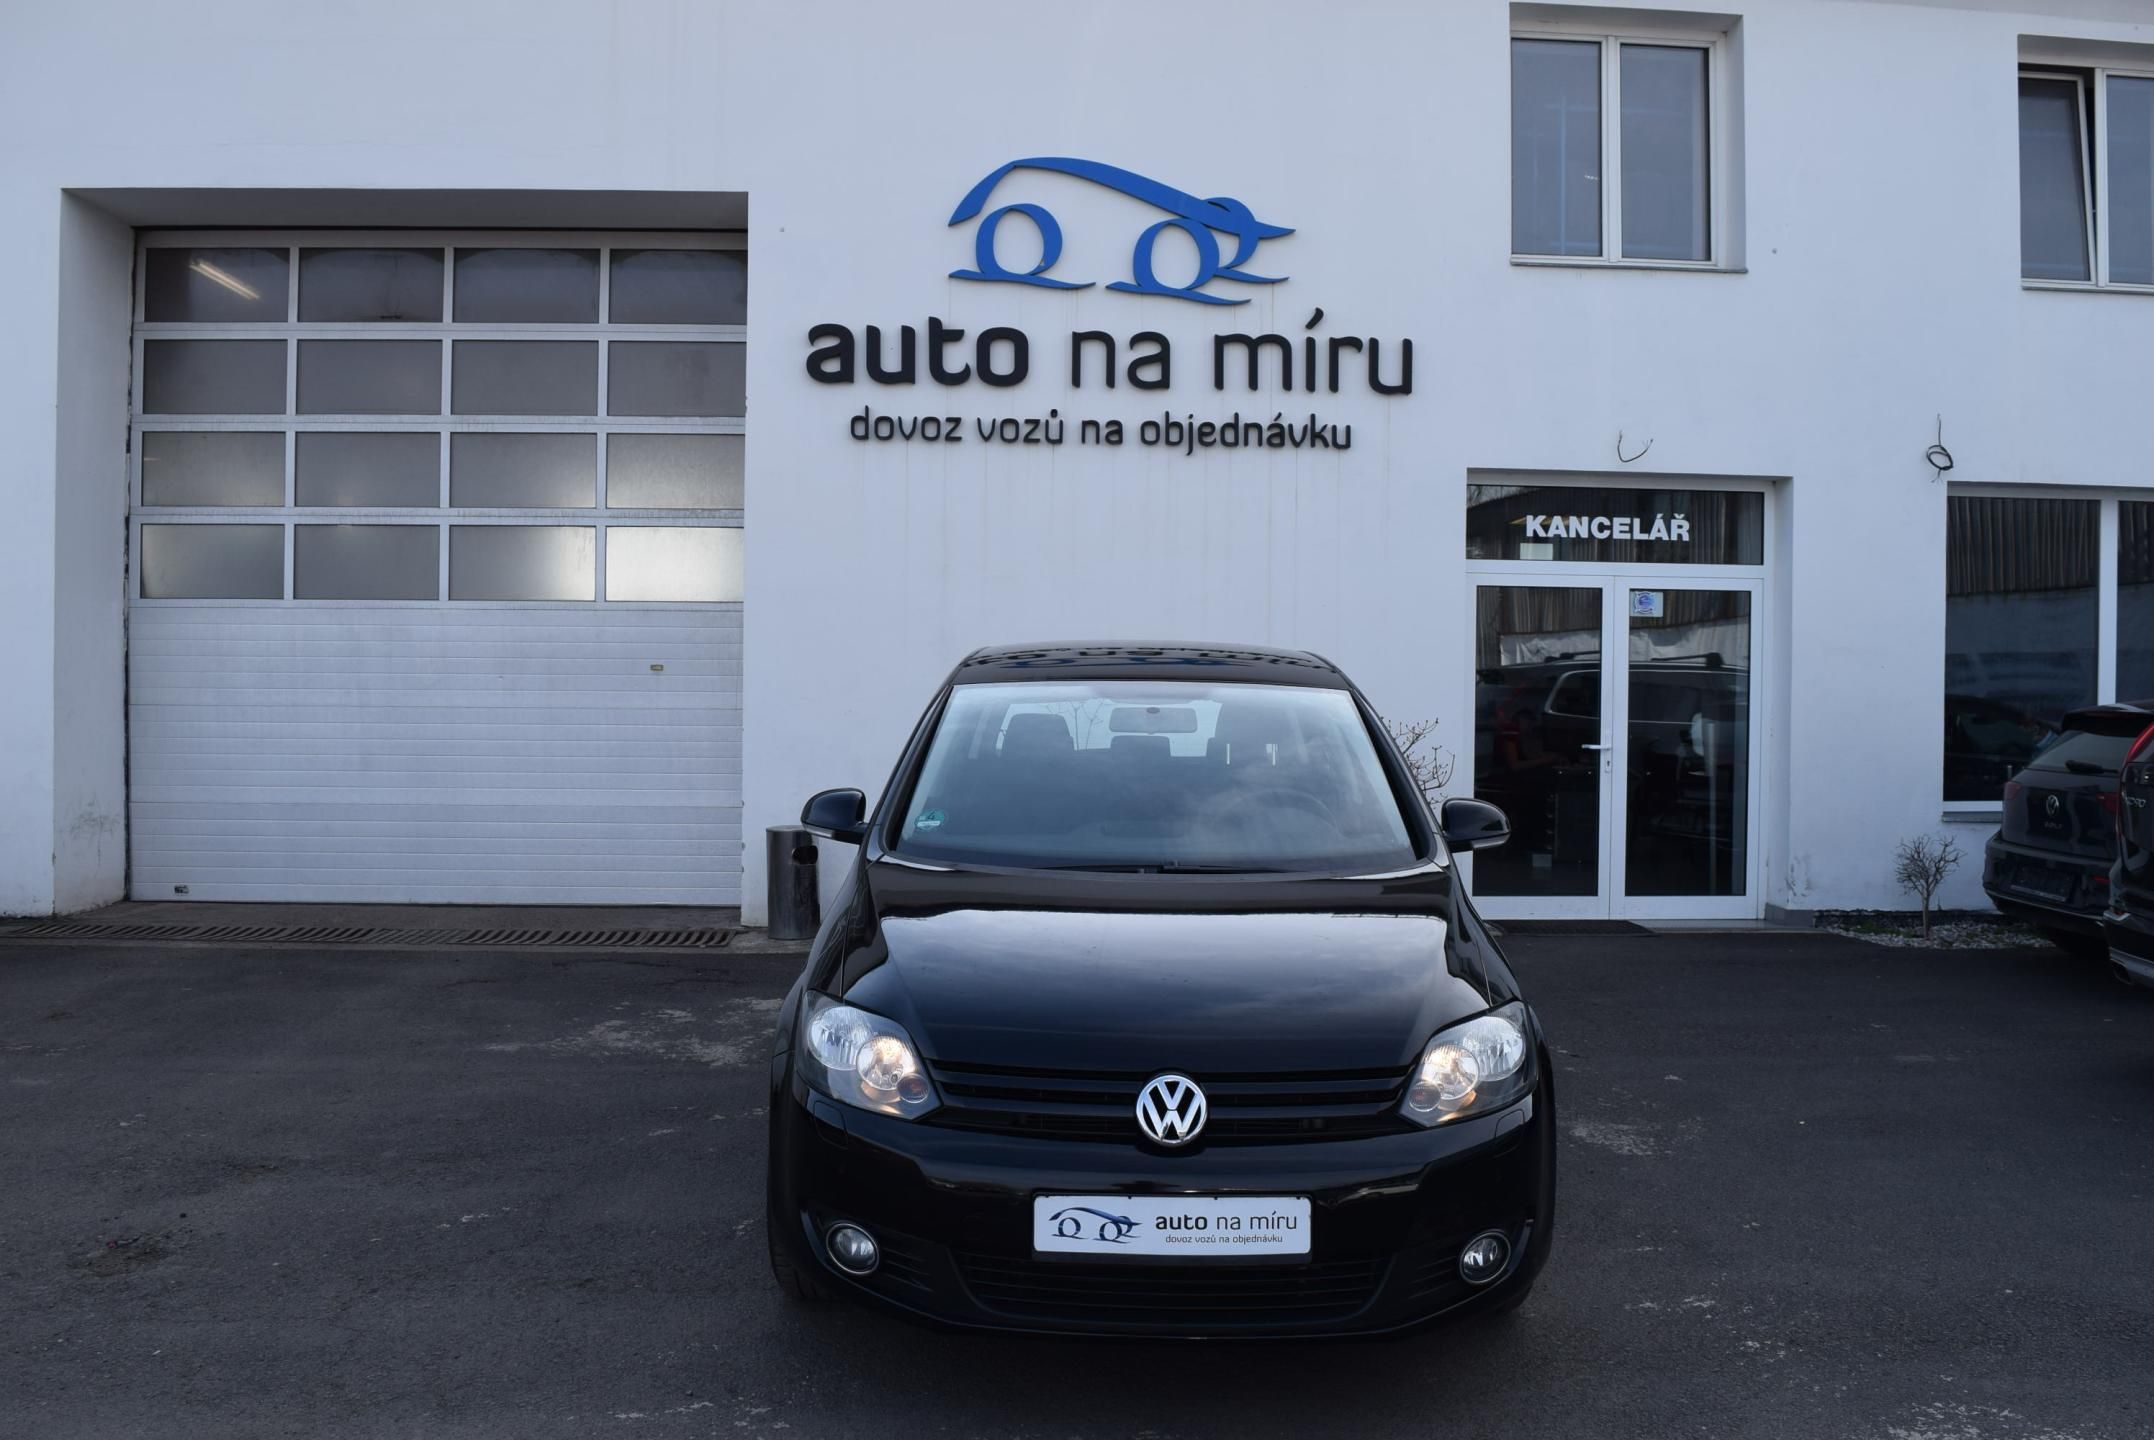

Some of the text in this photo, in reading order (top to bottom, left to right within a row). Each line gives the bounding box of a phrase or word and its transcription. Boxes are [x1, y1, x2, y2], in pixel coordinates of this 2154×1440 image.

[805, 307, 1413, 397] auto na míru
[849, 405, 1352, 457] dovoz vozů na objednávku
[1526, 513, 1691, 542] KANCELÁŘ
[1155, 1210, 1298, 1231] auto na míru
[1165, 1234, 1284, 1245] dovoz vozů na objednávku
